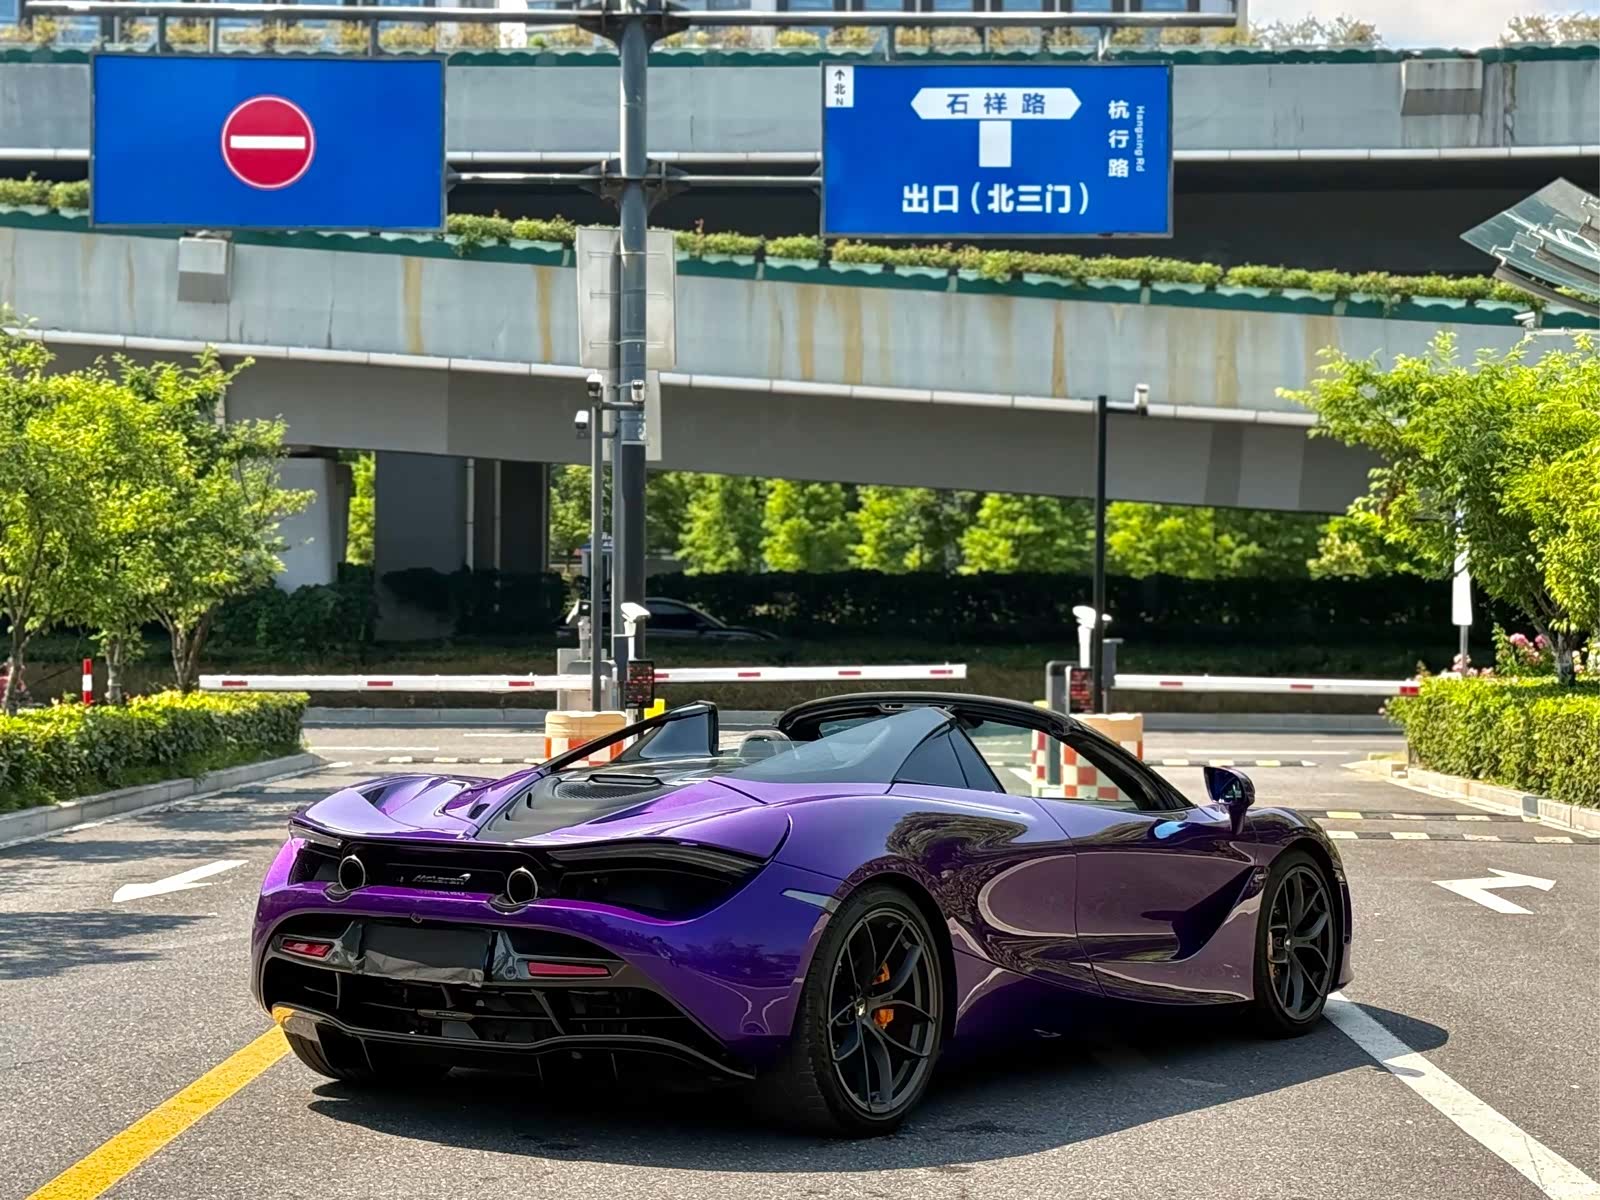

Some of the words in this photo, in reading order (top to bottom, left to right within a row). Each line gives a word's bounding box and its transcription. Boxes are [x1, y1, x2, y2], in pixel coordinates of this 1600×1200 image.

[834, 83, 846, 95] 北
[836, 97, 844, 106] N
[946, 92, 1047, 115] 石祥路
[1108, 99, 1131, 178] 杭行路
[1134, 105, 1146, 156] Hangxing
[1135, 157, 1146, 172] Rd
